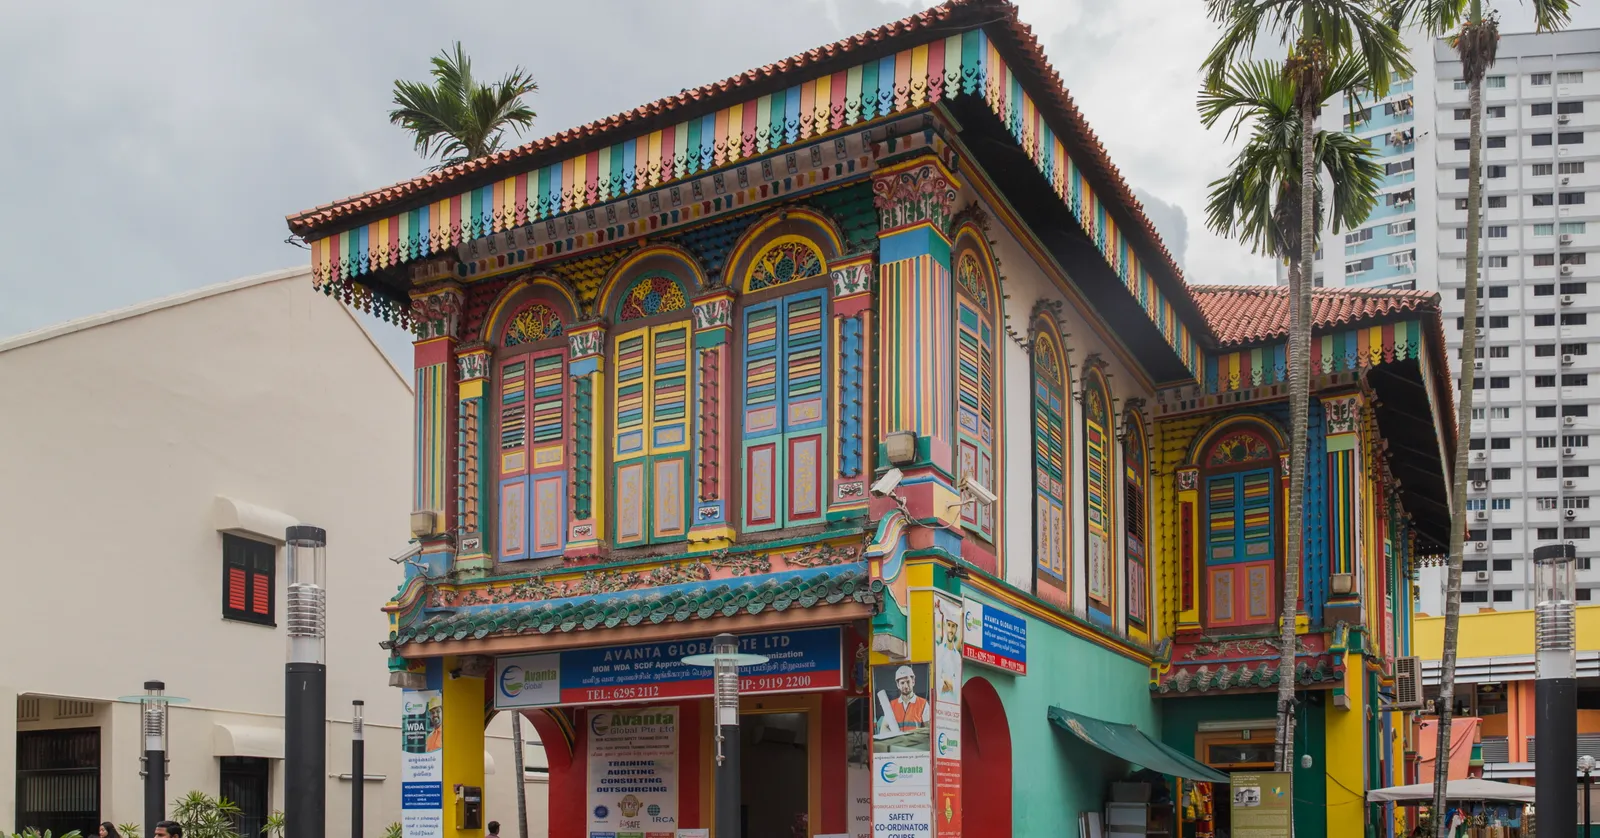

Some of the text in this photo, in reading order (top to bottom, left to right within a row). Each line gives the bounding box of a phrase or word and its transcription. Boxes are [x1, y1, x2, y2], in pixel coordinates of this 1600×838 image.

[984, 614, 1000, 626] AVANTA
[604, 646, 662, 662] AVANTA
[668, 642, 715, 657] GLOBA
[764, 635, 791, 649] LTD
[966, 647, 978, 659] TEL:
[592, 650, 804, 673] MOM WDA SCDF Approve anization
[524, 669, 557, 683] Avanta
[523, 682, 543, 691] Global
[759, 677, 783, 690] 9119
[786, 675, 812, 688] 2200
[586, 685, 660, 701] TEL: 6295 2112
[611, 713, 674, 727] Avanta
[407, 723, 425, 731] WDA
[610, 725, 675, 735] Global Pte Ltd
[899, 765, 924, 774] Avanta
[888, 813, 914, 821] SAFETY
[874, 823, 929, 832] CO-ORDINATOR
